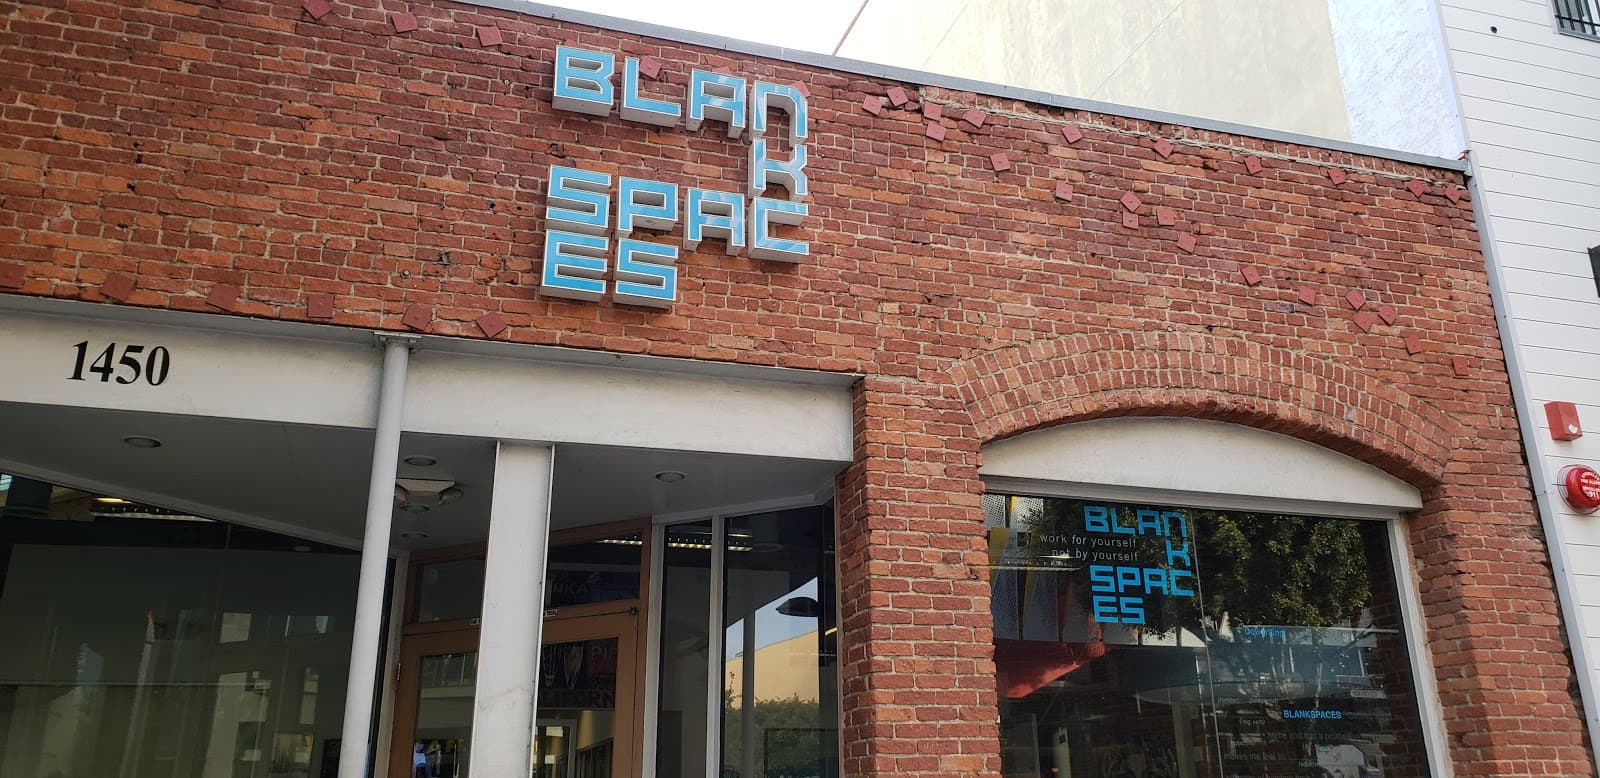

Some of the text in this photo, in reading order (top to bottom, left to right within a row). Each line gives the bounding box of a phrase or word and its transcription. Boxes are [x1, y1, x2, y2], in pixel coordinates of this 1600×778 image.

[753, 138, 808, 196] K
[546, 164, 809, 256] SPAC
[542, 228, 679, 301] ES
[65, 340, 170, 386] 1450
[1039, 533, 1137, 548] work for yourself
[1052, 547, 1138, 561] not by yourself
[1166, 539, 1191, 567] K
[1089, 564, 1195, 596] SPAC
[1092, 595, 1146, 624] ES
[1283, 709, 1342, 720] BLANKSPACES
